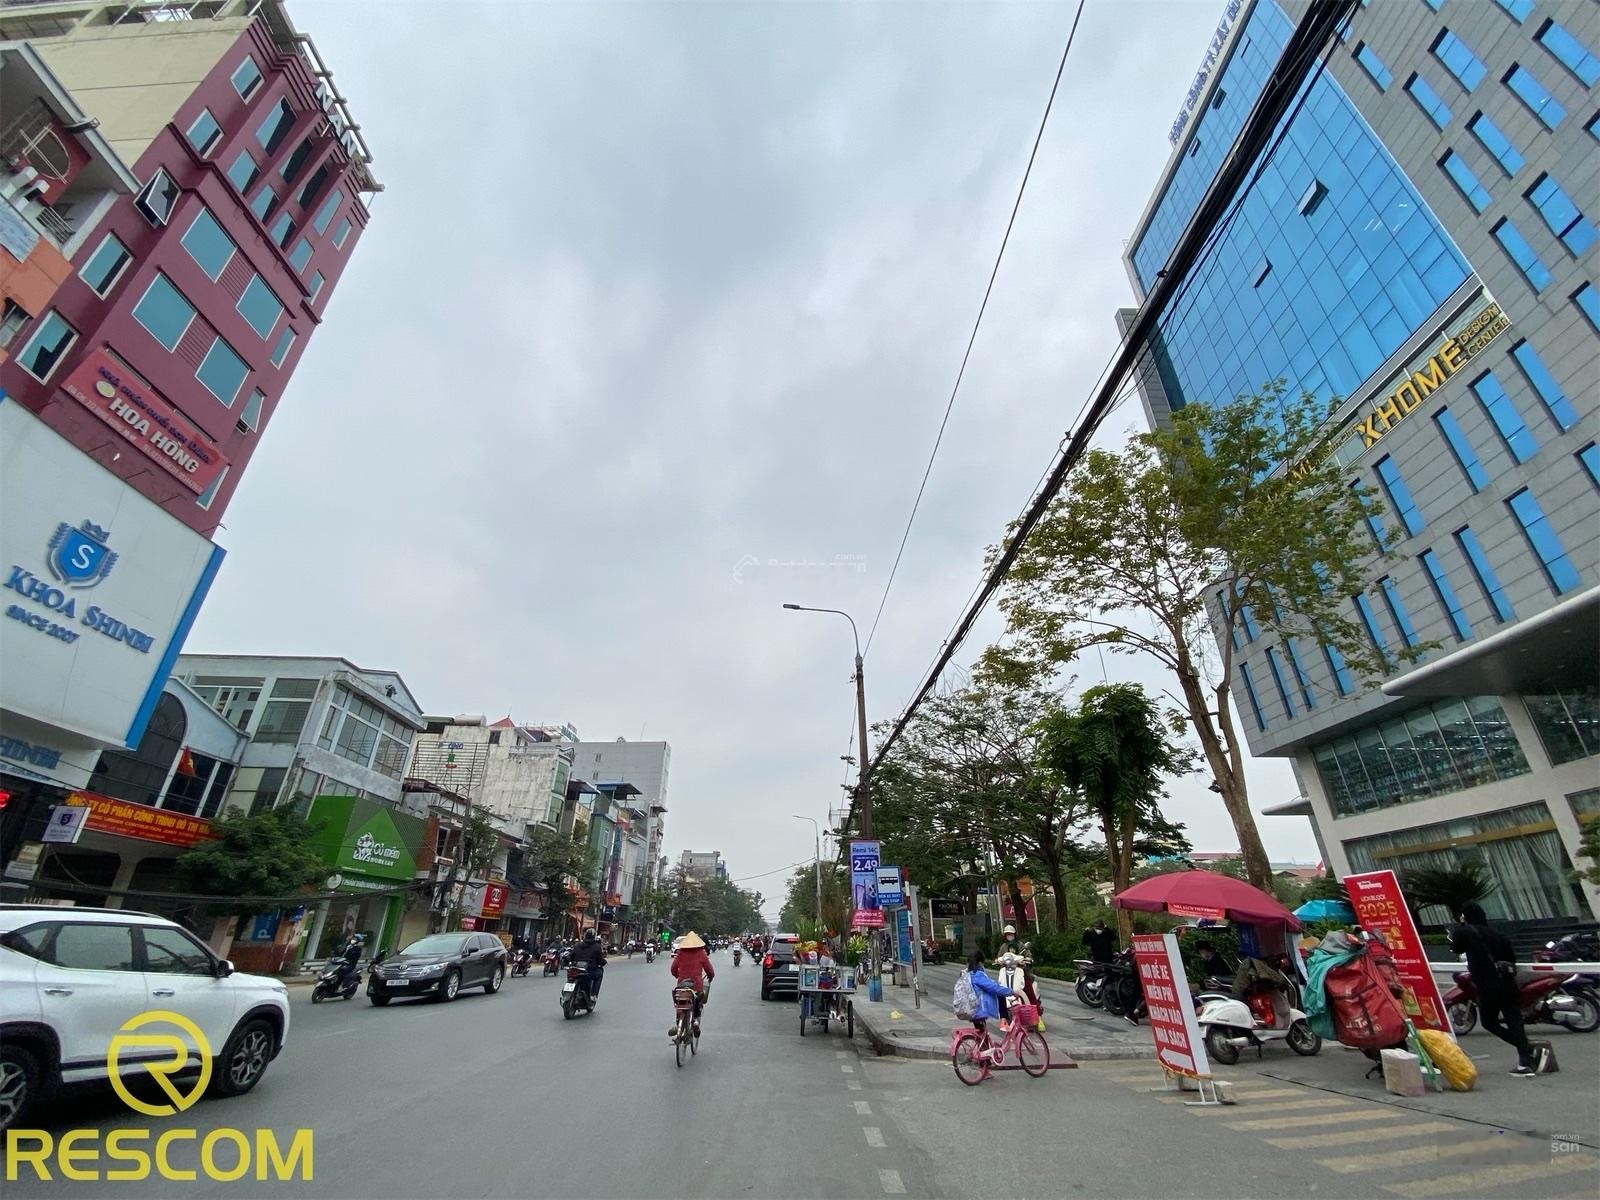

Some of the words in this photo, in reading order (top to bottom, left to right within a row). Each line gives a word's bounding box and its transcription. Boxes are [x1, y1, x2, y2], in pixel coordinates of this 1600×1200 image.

[1459, 304, 1500, 345] DESIGN
[1355, 339, 1468, 448] XHOME
[109, 397, 150, 436] HOA
[150, 430, 199, 473] HỒNG
[71, 544, 94, 569] S
[3, 565, 76, 619] KHOA
[1359, 901, 1398, 917] 2025
[1159, 965, 1170, 980] XE
[1161, 983, 1175, 1002] PHÍ
[1149, 1004, 1170, 1022] KHÁCH
[1168, 1006, 1183, 1025] VÀO
[1155, 1026, 1169, 1043] NHÀ
[1168, 1028, 1187, 1048] SÁCH
